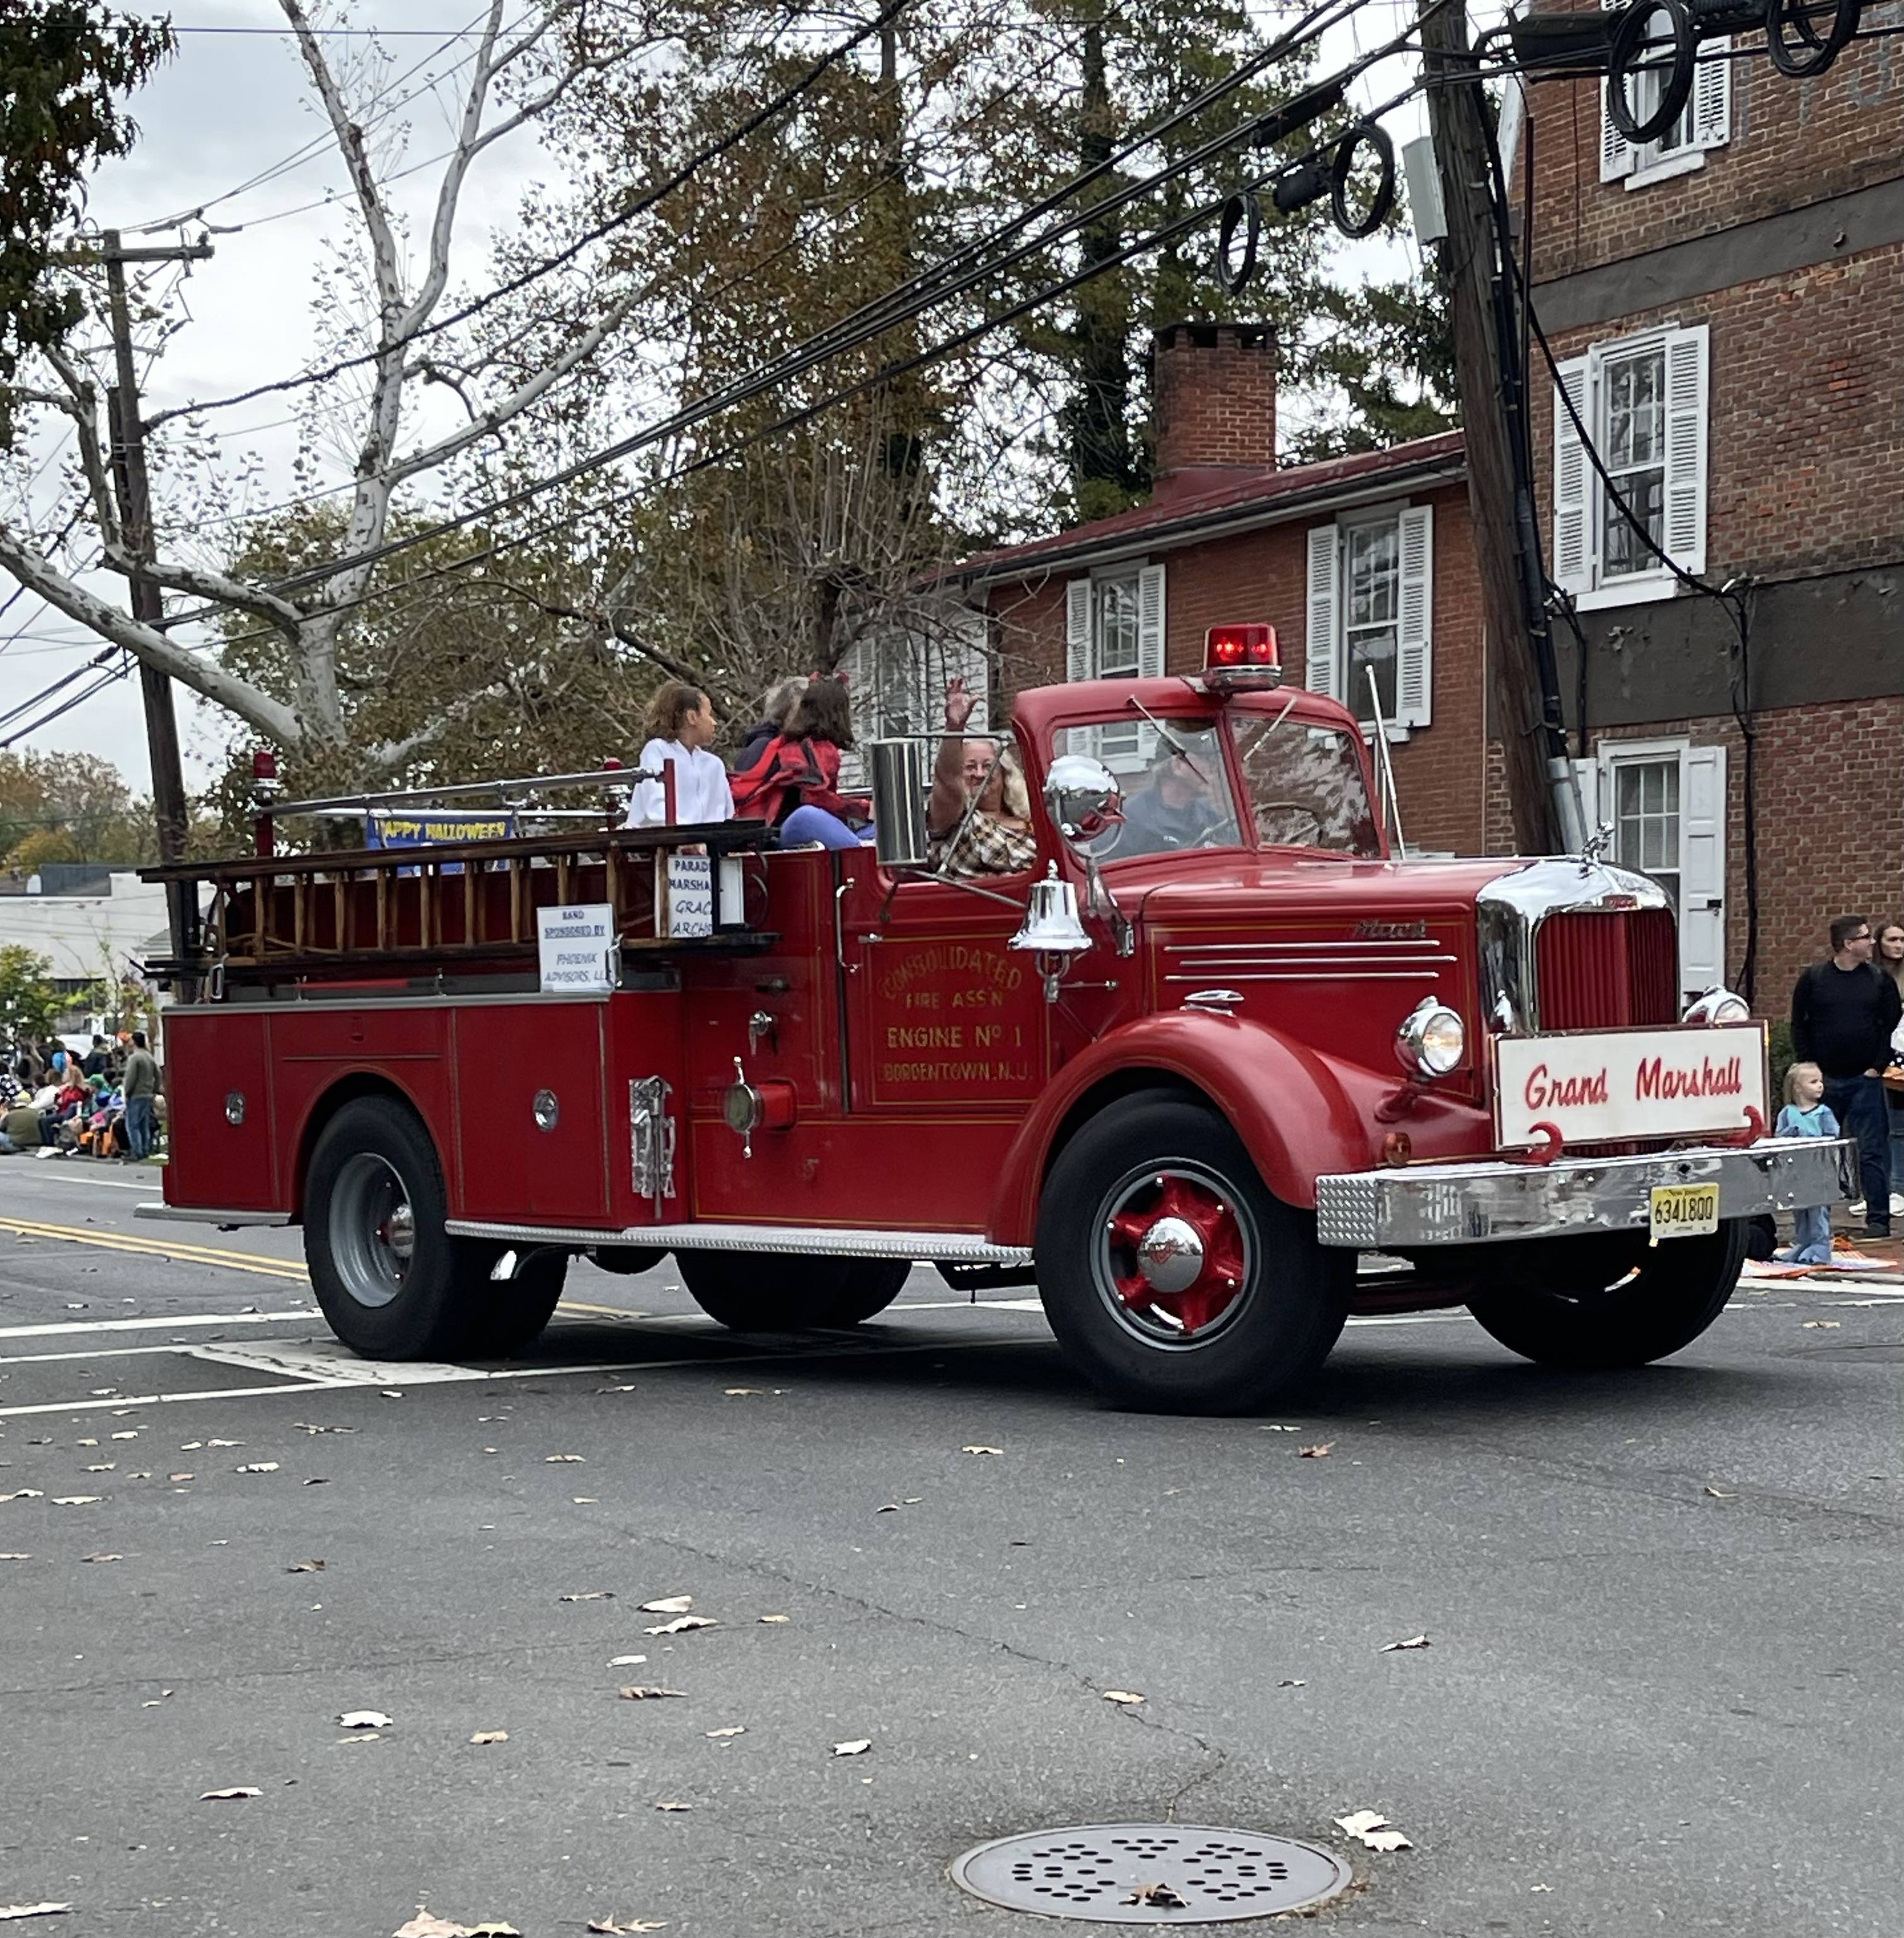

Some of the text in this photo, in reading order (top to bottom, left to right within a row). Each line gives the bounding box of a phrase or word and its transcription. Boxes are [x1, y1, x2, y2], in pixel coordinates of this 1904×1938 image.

[674, 860, 710, 872] PARAD
[669, 878, 711, 891] MARSHA
[675, 900, 711, 915] GRAC
[594, 970, 608, 981] LL
[906, 993, 940, 1008] FIRE
[887, 1027, 962, 1048] ENGINE
[1015, 1025, 1022, 1047] 1
[1525, 1056, 1741, 1110] Grand Marshall
[1655, 1196, 1713, 1225] 6341800
